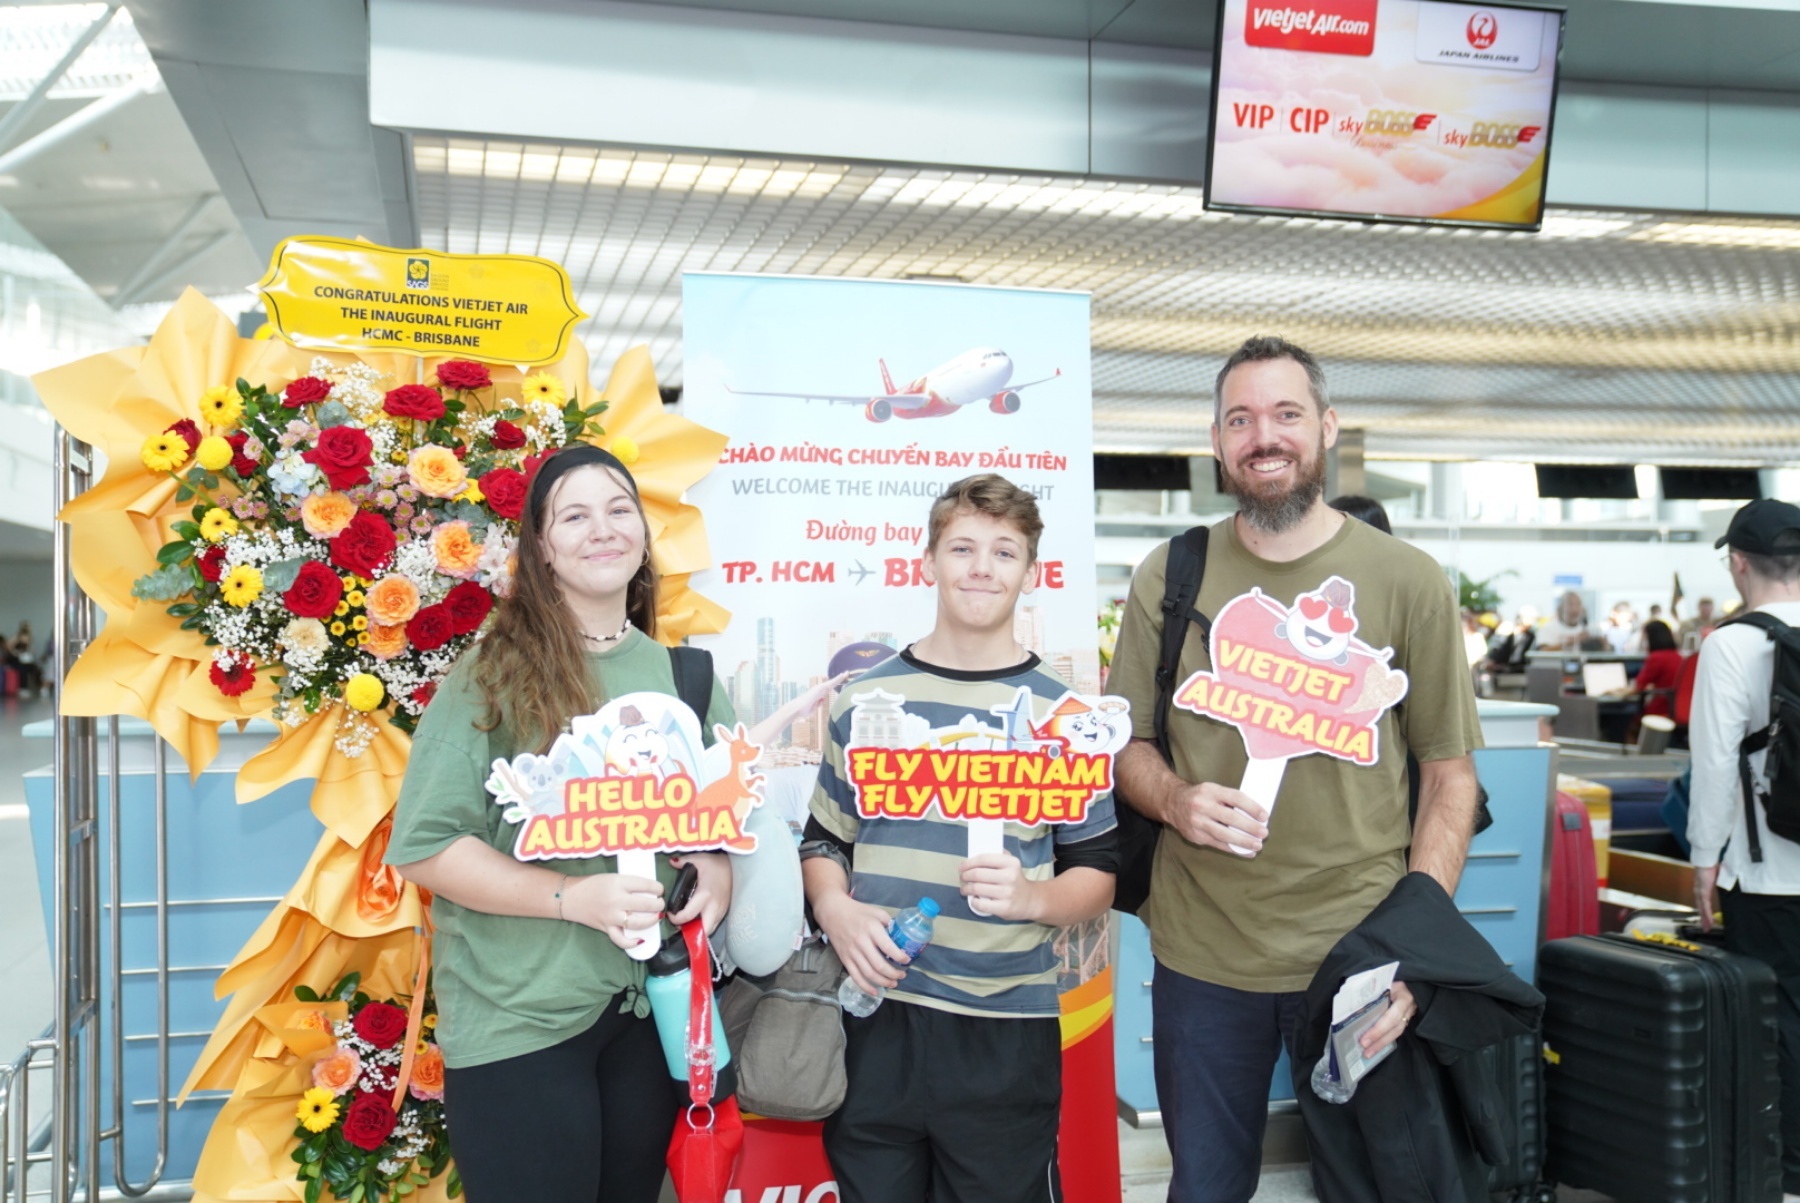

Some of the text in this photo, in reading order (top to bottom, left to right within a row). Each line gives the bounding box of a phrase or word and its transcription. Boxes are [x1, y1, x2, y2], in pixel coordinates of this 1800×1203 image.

[1439, 49, 1520, 63] JAPAN AIRLINES
[1233, 102, 1275, 129] VIP
[1290, 107, 1330, 134] CIP
[407, 280, 429, 289] SAGS
[314, 285, 528, 315] CONGRATULATIONS VIETJET AIR
[341, 306, 502, 331] THE INAUGURAL FLIGHT
[362, 327, 403, 342] HCMC
[414, 331, 480, 347] BRISBANE
[780, 441, 843, 466] MỪNG
[847, 442, 931, 467] CHUYẾN
[935, 450, 974, 468] BAY
[978, 445, 1022, 469] ĐẦU
[1026, 450, 1067, 471] TIÊN
[732, 477, 952, 499] WELCOME THE INAUG
[806, 519, 923, 547] Đường bay
[722, 560, 835, 584] TP. HCM
[1219, 639, 1351, 702] VIETJET
[1181, 679, 1371, 760] AUSTRALIA
[853, 752, 1106, 786] FLY VIETNAM
[568, 777, 693, 813] HELLO
[863, 784, 1088, 821] FLY VIETJET
[524, 810, 738, 852] AUSTRALIA
